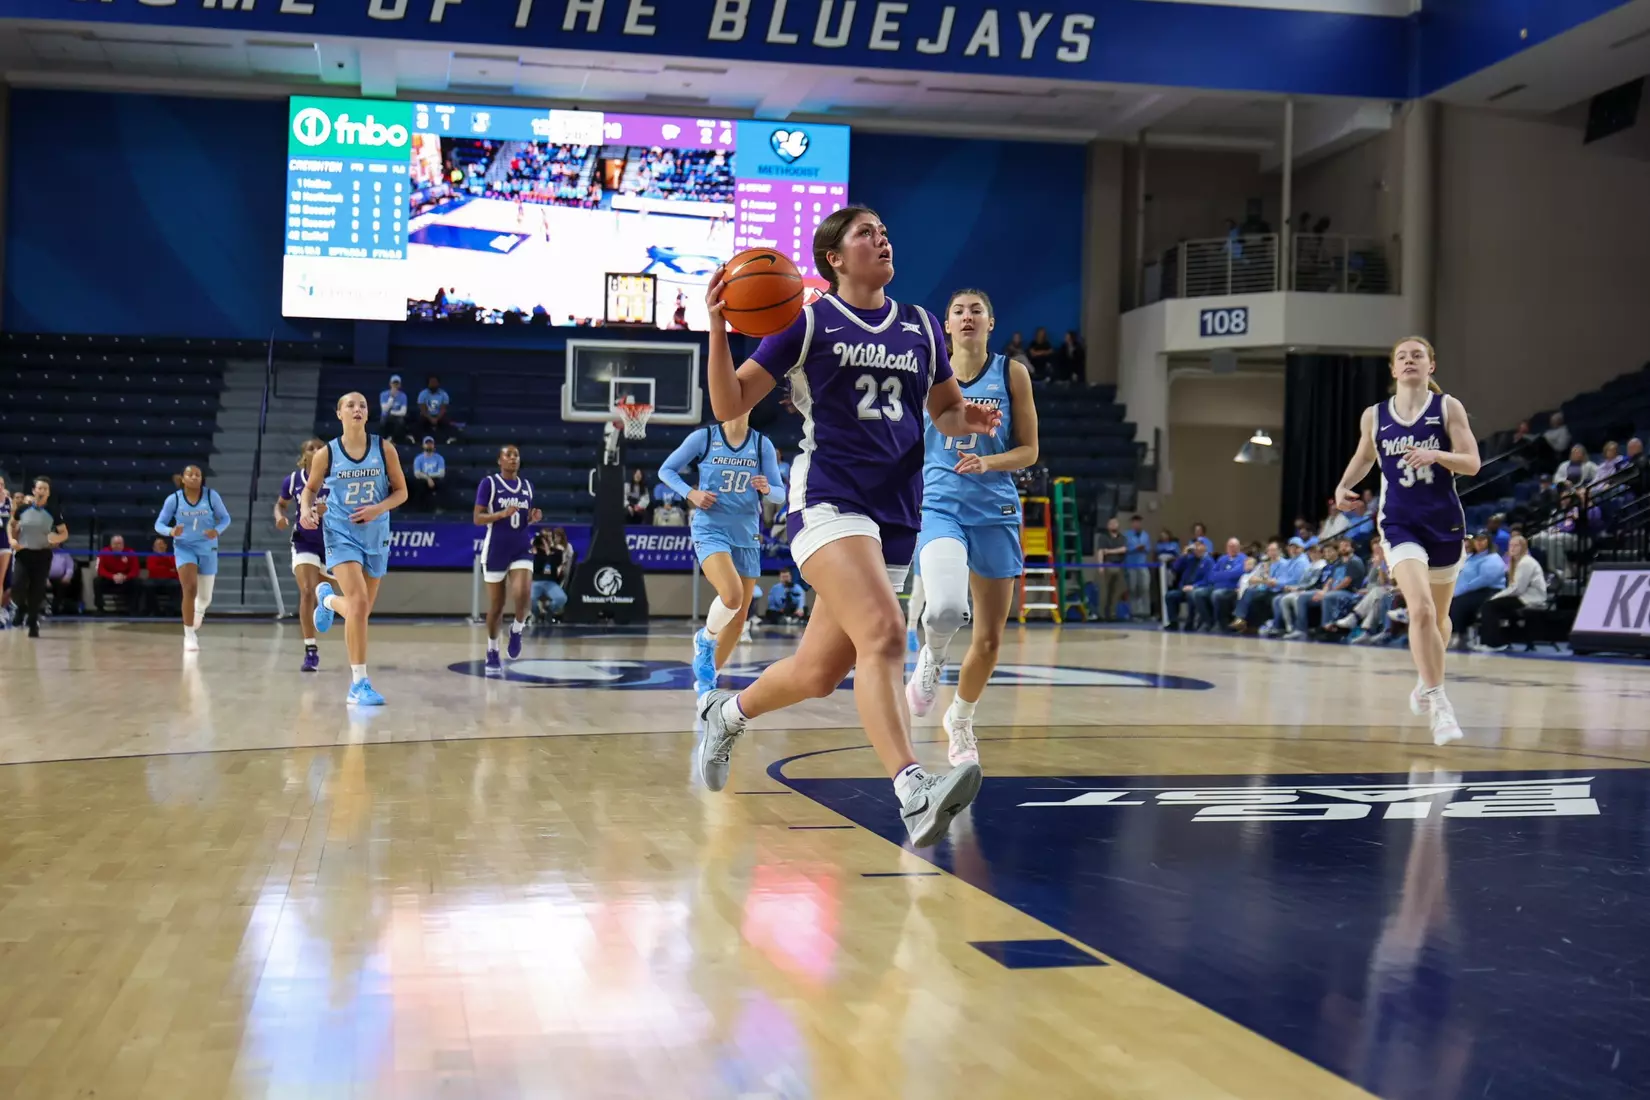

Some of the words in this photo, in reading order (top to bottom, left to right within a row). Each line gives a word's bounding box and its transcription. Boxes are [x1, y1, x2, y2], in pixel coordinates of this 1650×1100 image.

[514, 0, 657, 35] THE
[708, 0, 1096, 63] BLUEJAYS
[334, 113, 408, 147] fnbo
[757, 165, 820, 178] METHODIST
[1202, 309, 1246, 335] 108
[832, 342, 919, 374] Wildcats
[855, 374, 904, 422] 23
[336, 468, 381, 479] CREIGHTON
[712, 456, 758, 468] CREIGHTON
[1396, 457, 1435, 488] 34
[344, 480, 376, 505] 23
[719, 469, 751, 494] 30
[510, 511, 520, 529] 0
[626, 534, 693, 551] CREIGHT
[639, 553, 694, 562] BLUEJAY
[1602, 574, 1650, 629] Ki
